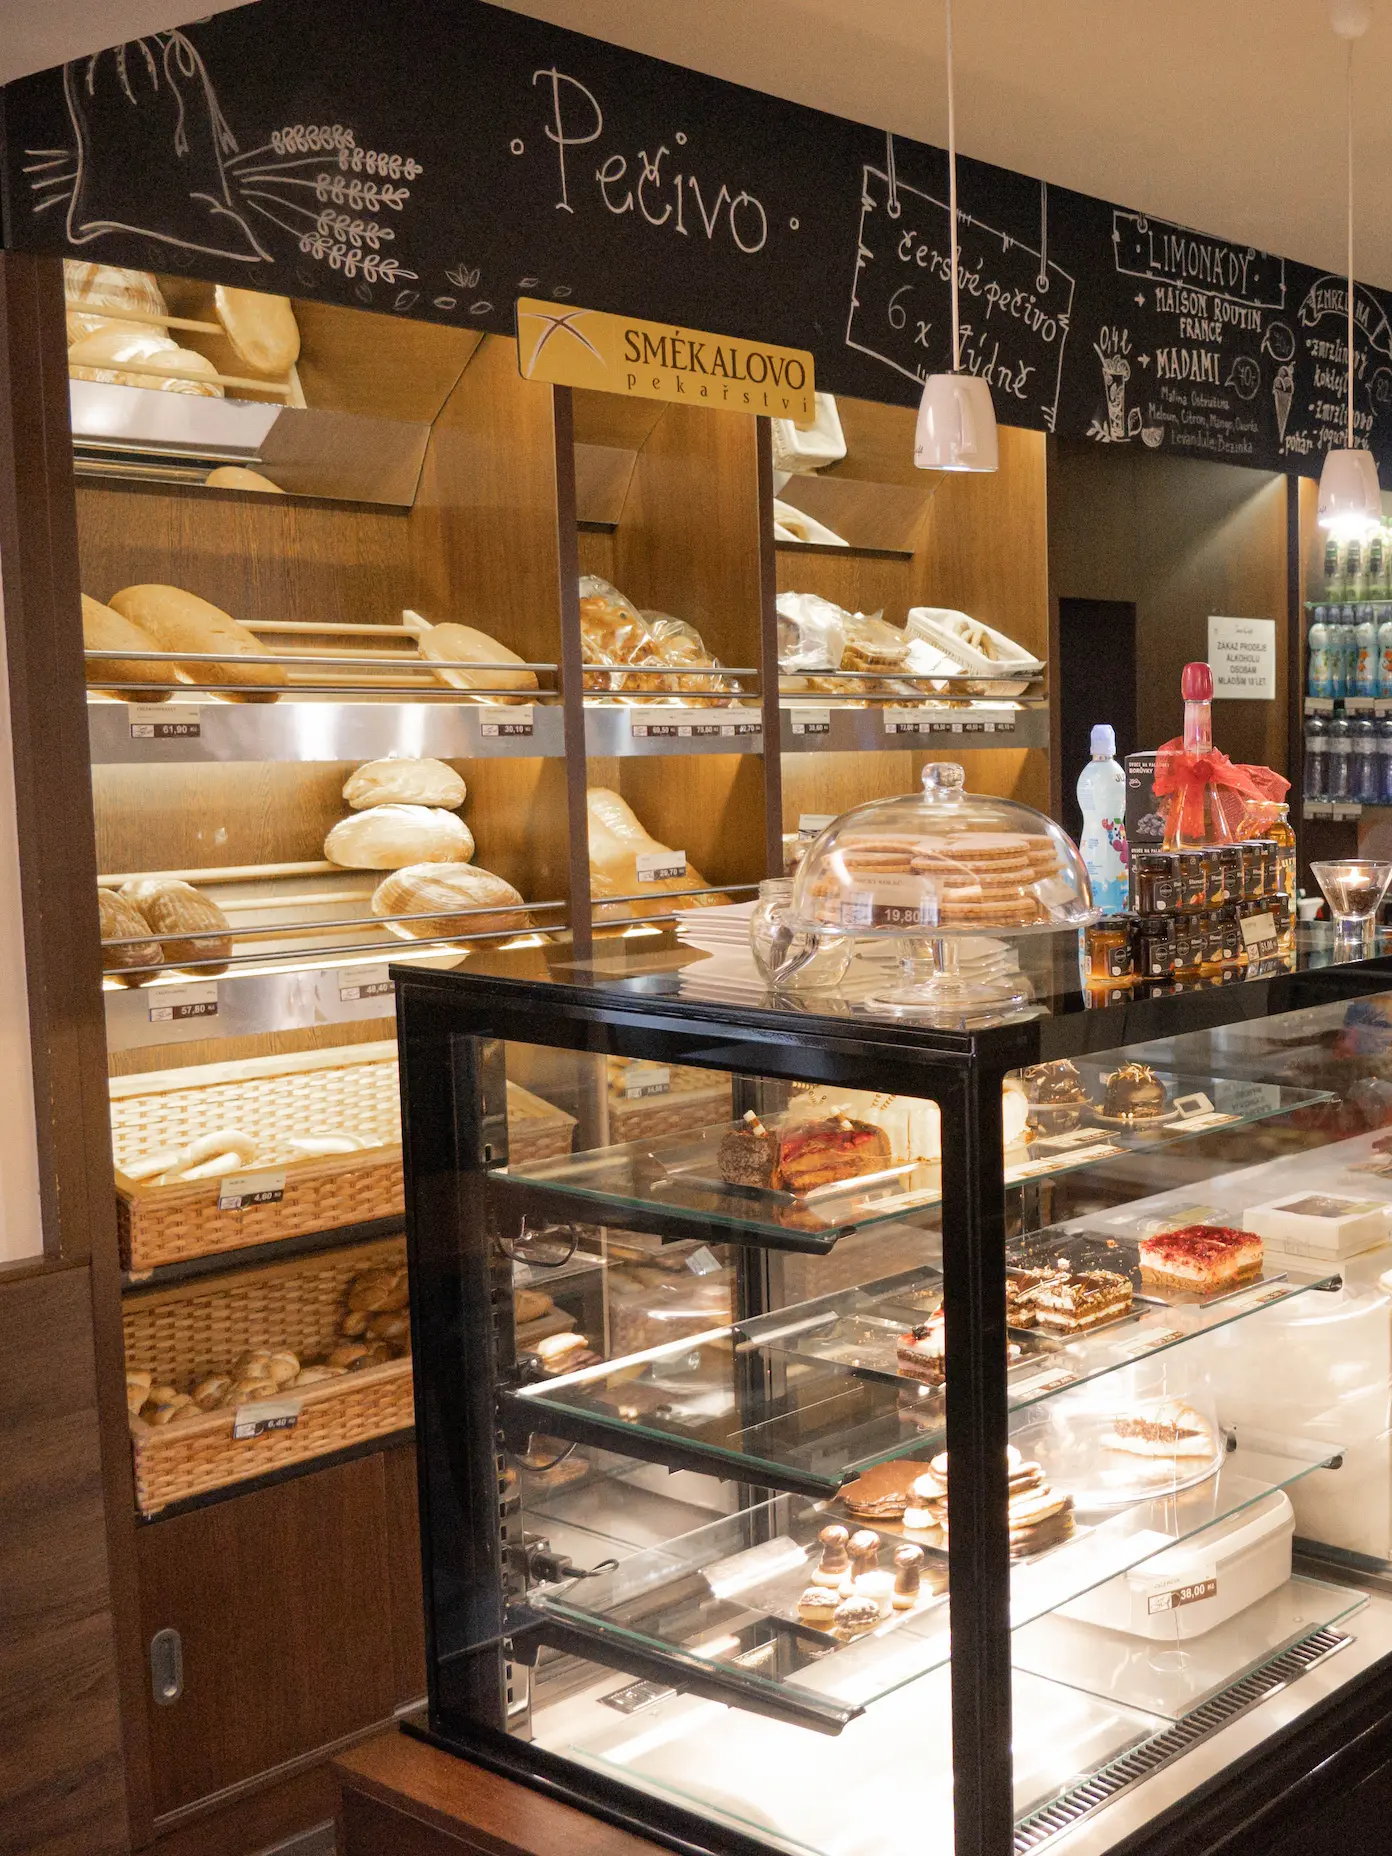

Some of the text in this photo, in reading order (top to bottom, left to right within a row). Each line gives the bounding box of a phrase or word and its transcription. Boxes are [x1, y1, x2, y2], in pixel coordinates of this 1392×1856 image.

[533, 66, 768, 254] Pečivo
[888, 284, 914, 330] 6
[985, 281, 1057, 342] pečivo
[1155, 286, 1262, 333] MAISON ROUTIN
[1179, 317, 1223, 344] FRANCE
[624, 329, 806, 390] SMÉKALOVO
[1156, 347, 1221, 386] MADAMI
[627, 375, 808, 412] pekařství
[884, 908, 921, 923] 19,80
[1180, 1583, 1205, 1600] 38,00
